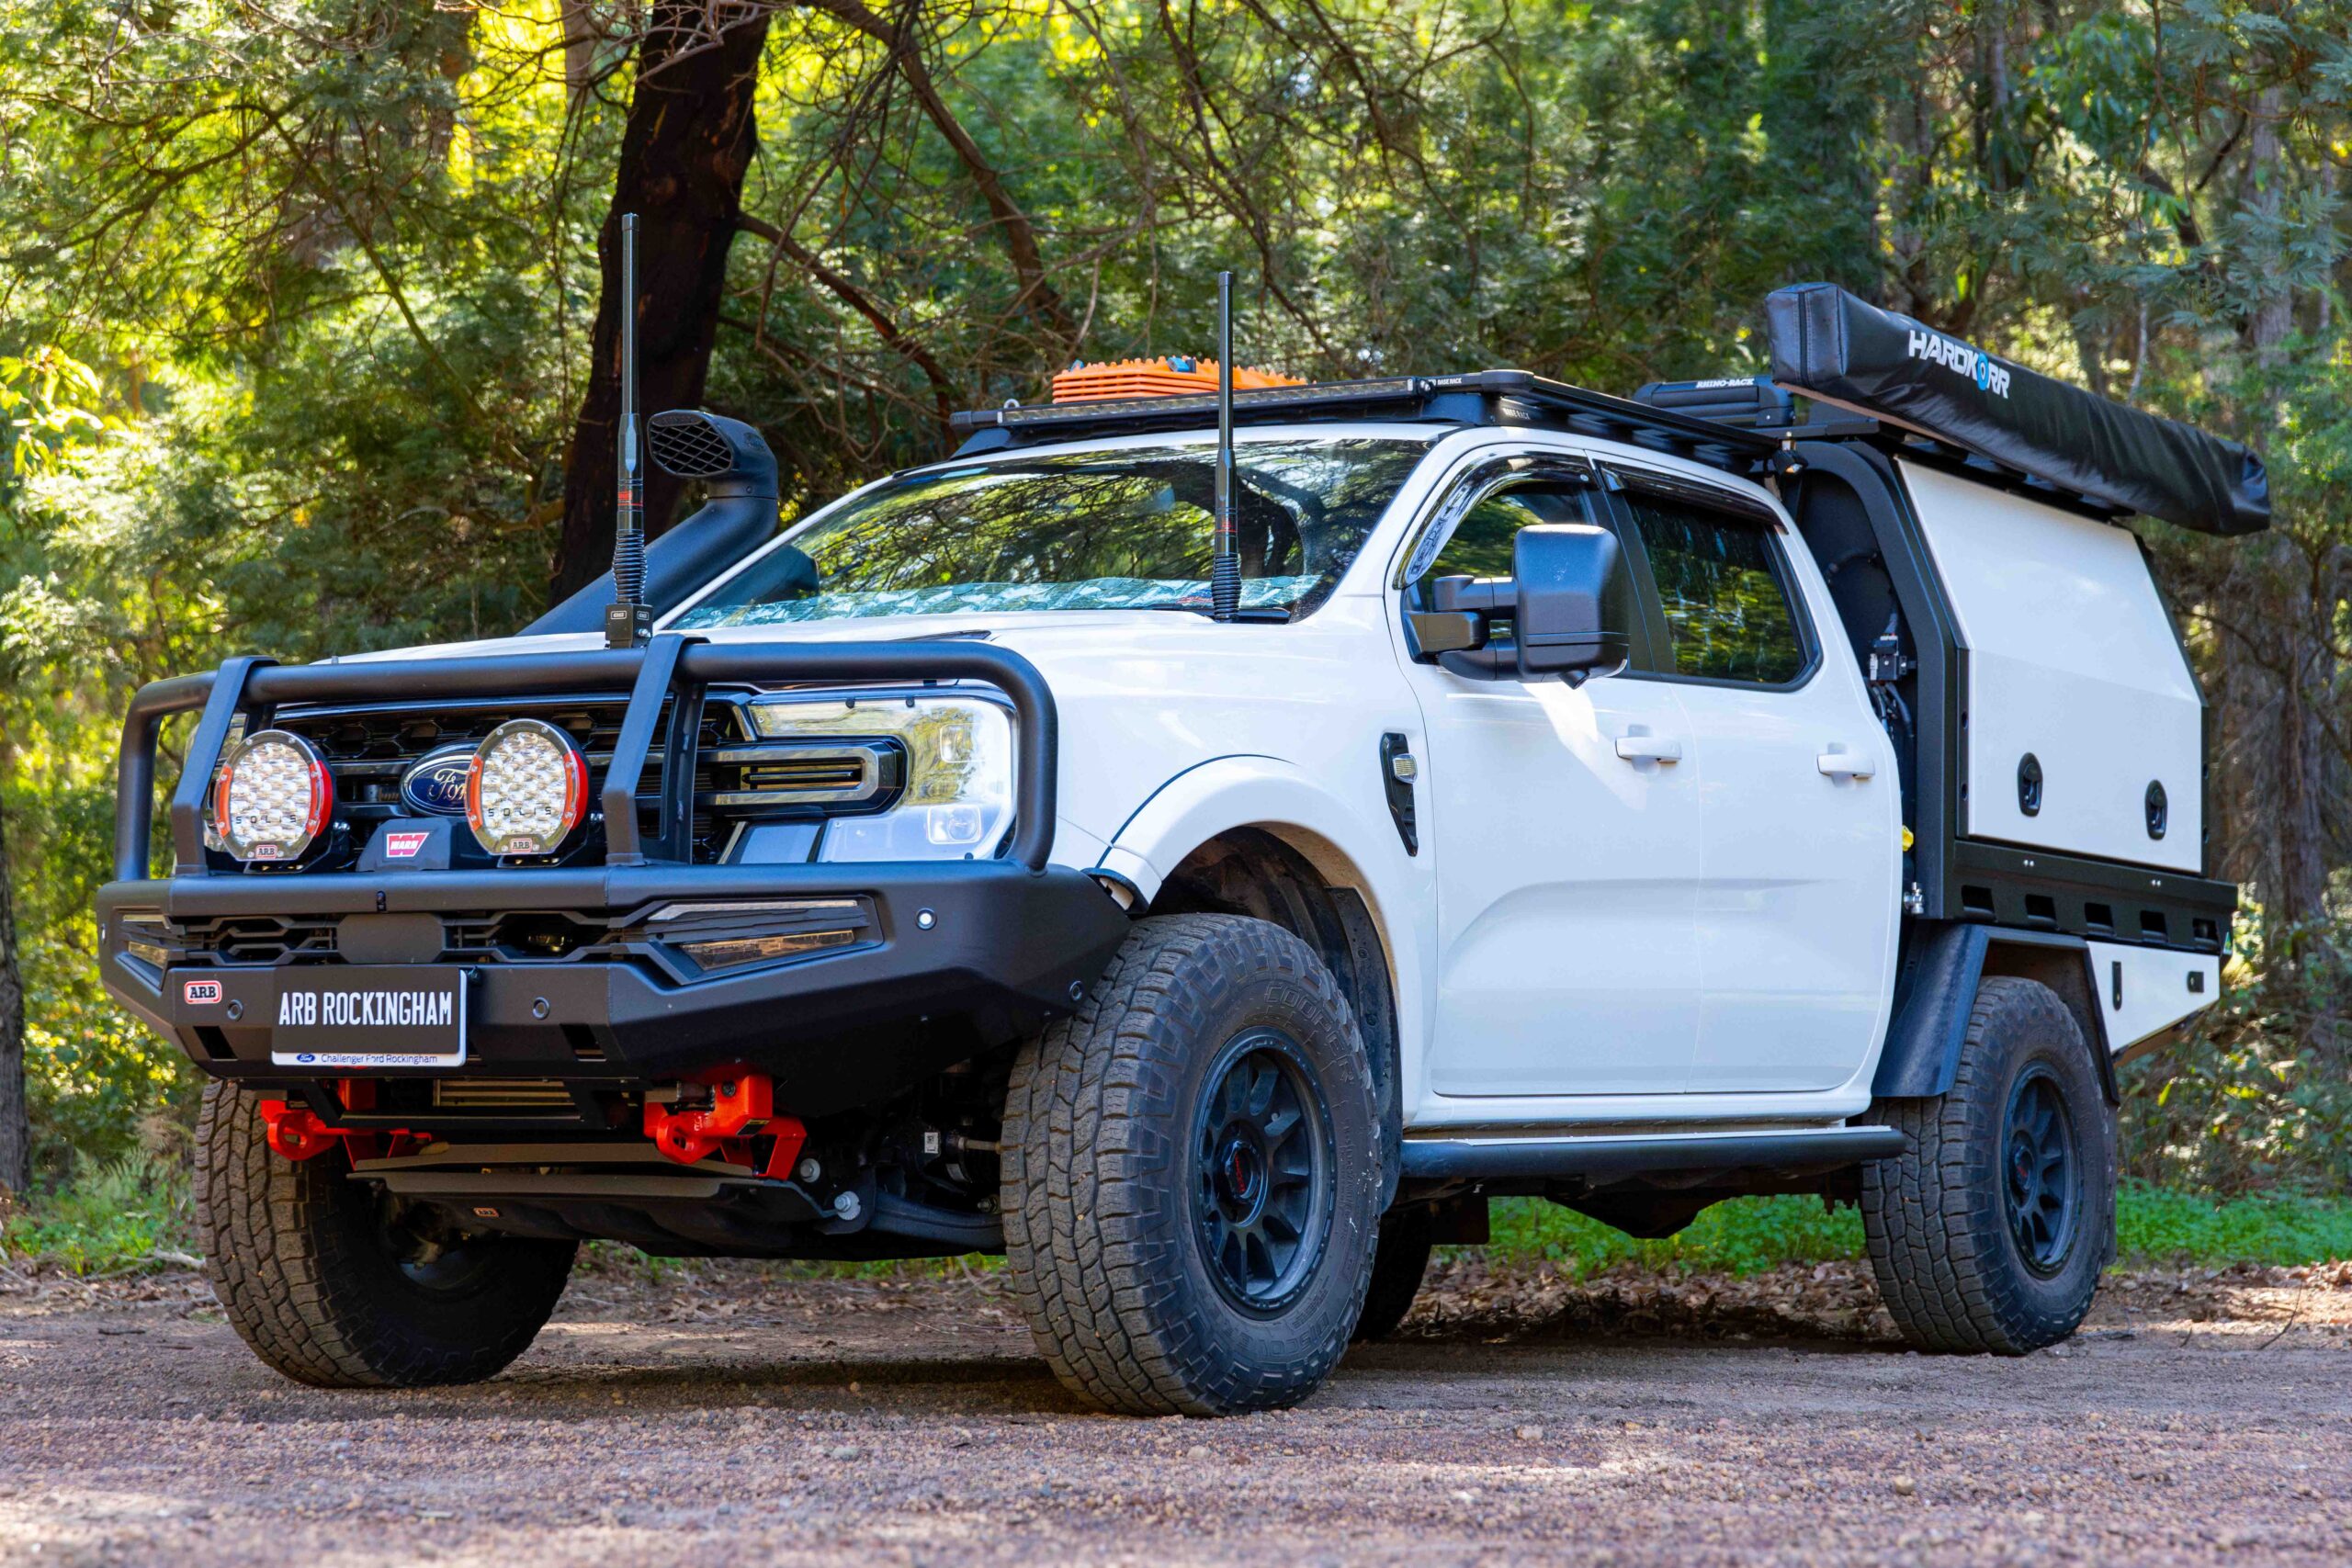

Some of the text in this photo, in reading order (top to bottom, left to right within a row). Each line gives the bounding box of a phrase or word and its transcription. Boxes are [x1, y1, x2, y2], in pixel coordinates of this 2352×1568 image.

[1908, 330, 2010, 399] HARDKORR
[1696, 378, 1755, 388] RHINO-RACK
[488, 807, 552, 818] SOLIS
[235, 814, 297, 825] SOLIS
[258, 847, 275, 855] ARB
[513, 841, 530, 850] ARB
[189, 987, 217, 998] ARB
[278, 992, 452, 1025] ARB ROCKINGHAM
[322, 1054, 365, 1065] Challenger
[386, 1055, 437, 1065] Rockingham
